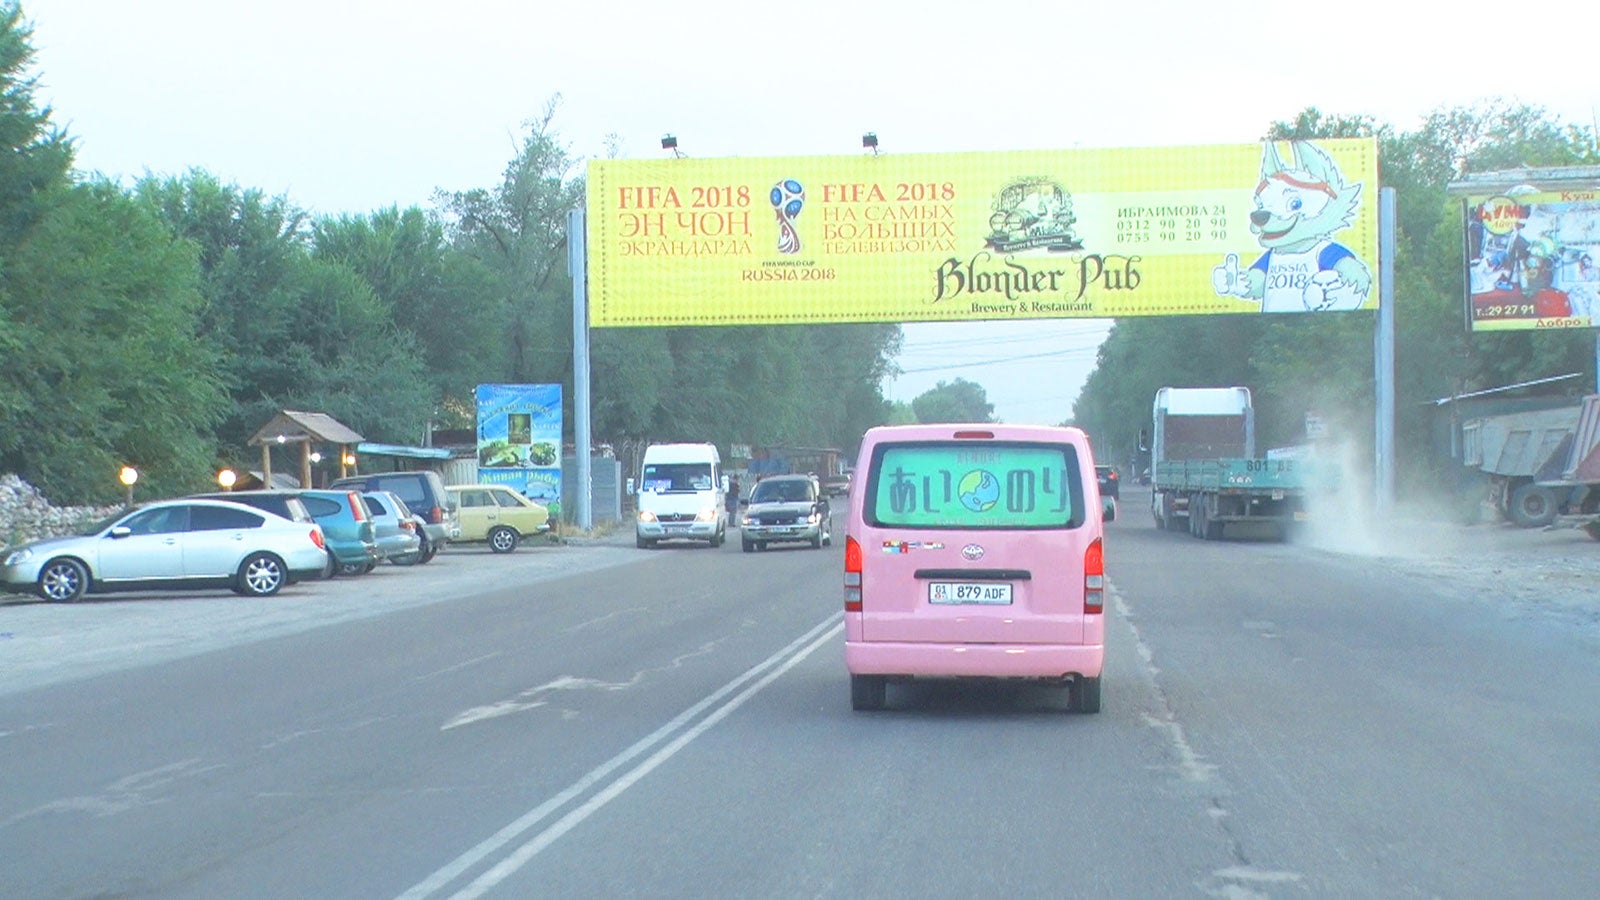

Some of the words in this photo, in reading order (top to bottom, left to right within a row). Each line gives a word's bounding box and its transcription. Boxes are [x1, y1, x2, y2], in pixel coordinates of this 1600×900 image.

[618, 186, 682, 209] FIFA
[691, 185, 751, 208] 2018
[822, 183, 887, 203] FIFA
[896, 182, 955, 201] 2018
[823, 206, 857, 221] НА
[864, 204, 954, 220] САМЫХ
[1117, 205, 1209, 218] ИБРАИМОВА
[1213, 204, 1226, 216] 24
[823, 221, 956, 240] БОЛЬШИХ
[1117, 219, 1150, 231] 0312
[1159, 218, 1176, 230] 90
[1185, 218, 1201, 229] 20
[1210, 217, 1227, 228] 90
[1117, 232, 1150, 243] 0755
[1159, 231, 1176, 242] 90
[1185, 230, 1201, 241] 20
[1210, 229, 1227, 241] 90
[618, 240, 753, 257] ЭКРАНДАРДА
[822, 239, 956, 255] ТЕЛЕВИЗОРАХ
[742, 269, 798, 281] RUSSIA
[800, 268, 836, 281] 2018
[930, 251, 1066, 304] Blonder
[1067, 252, 1142, 303] Pub
[1268, 273, 1307, 290] 2018
[970, 302, 1017, 316] Brewery
[1019, 302, 1028, 313] &
[1031, 301, 1093, 313] Restaurant
[1504, 304, 1518, 315] 27
[1520, 304, 1535, 314] 91
[1536, 318, 1582, 329] Добро
[935, 585, 947, 594] 01
[956, 585, 982, 599] 879
[984, 587, 1006, 600] ADF
